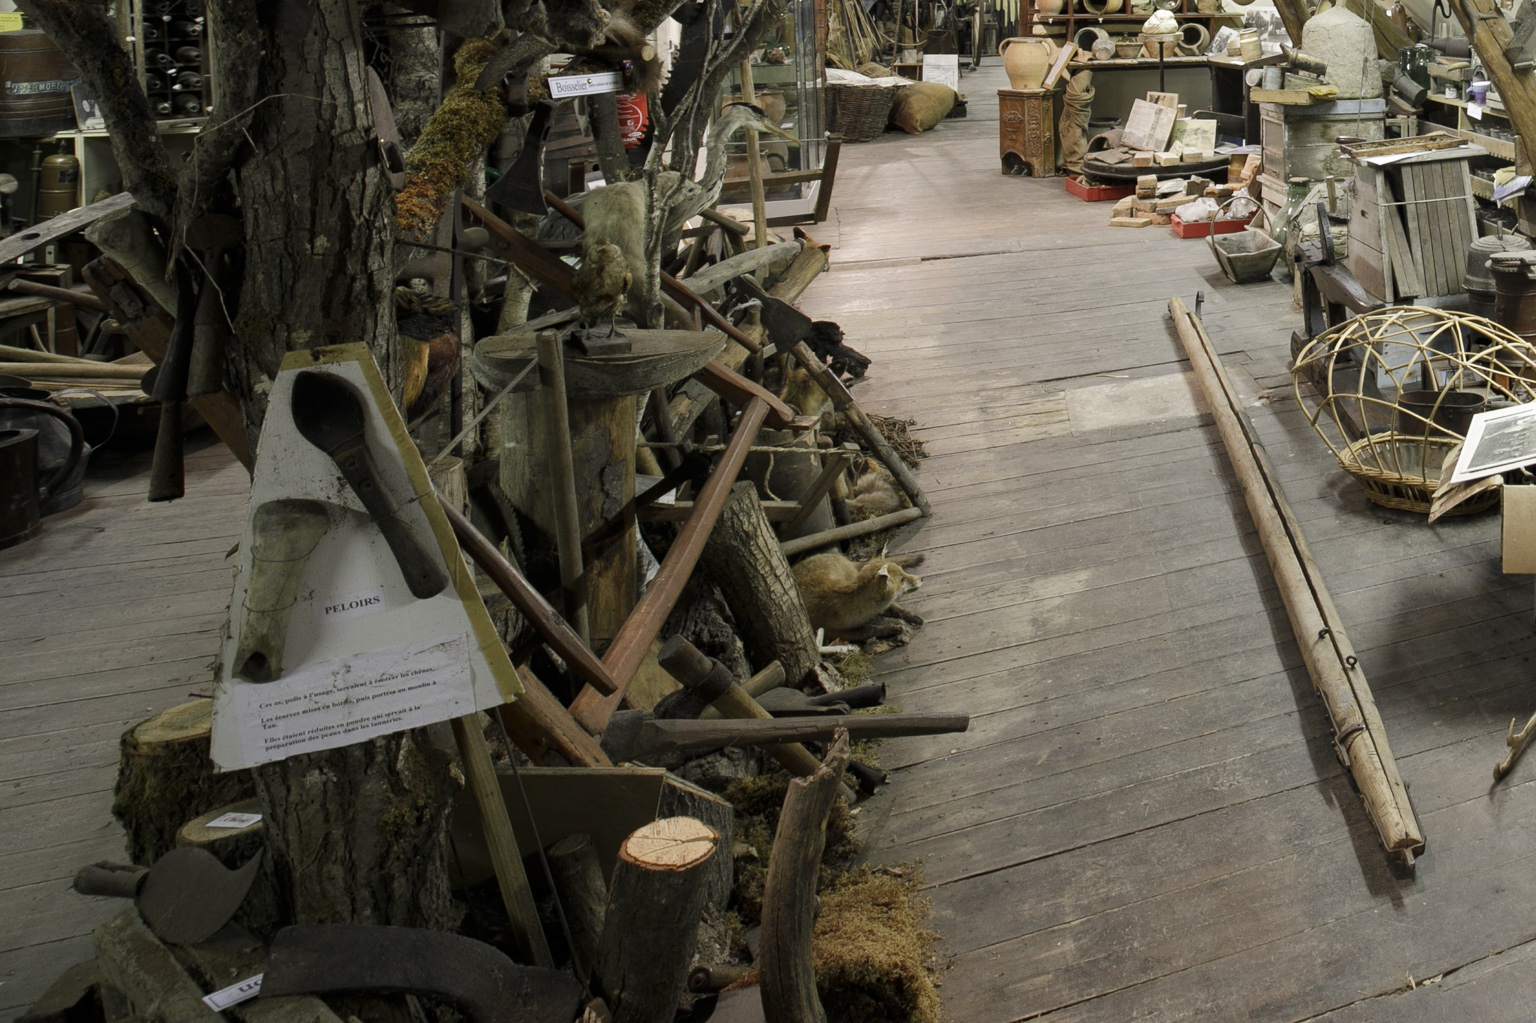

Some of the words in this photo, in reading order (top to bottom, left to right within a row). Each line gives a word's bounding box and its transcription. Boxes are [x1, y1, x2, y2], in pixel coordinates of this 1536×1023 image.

[556, 81, 587, 93] Boisselier
[324, 595, 380, 615] PELOIRS
[274, 710, 300, 720] écorces
[355, 694, 370, 703] puis
[371, 689, 396, 699] portées
[407, 680, 431, 690] moulin
[285, 694, 301, 704] polis
[309, 687, 335, 699] l'usage,
[337, 680, 367, 692] servaient
[262, 721, 278, 730] Tan.
[264, 735, 280, 744] Elles
[282, 730, 305, 740] étaient
[307, 723, 334, 734] réduites
[346, 715, 369, 727] poudre
[371, 712, 383, 721] qui
[384, 708, 406, 717] servait
[265, 737, 305, 752] préparation
[320, 729, 340, 739] peaux
[342, 725, 358, 733] dans
[370, 715, 403, 727] tanneries.
